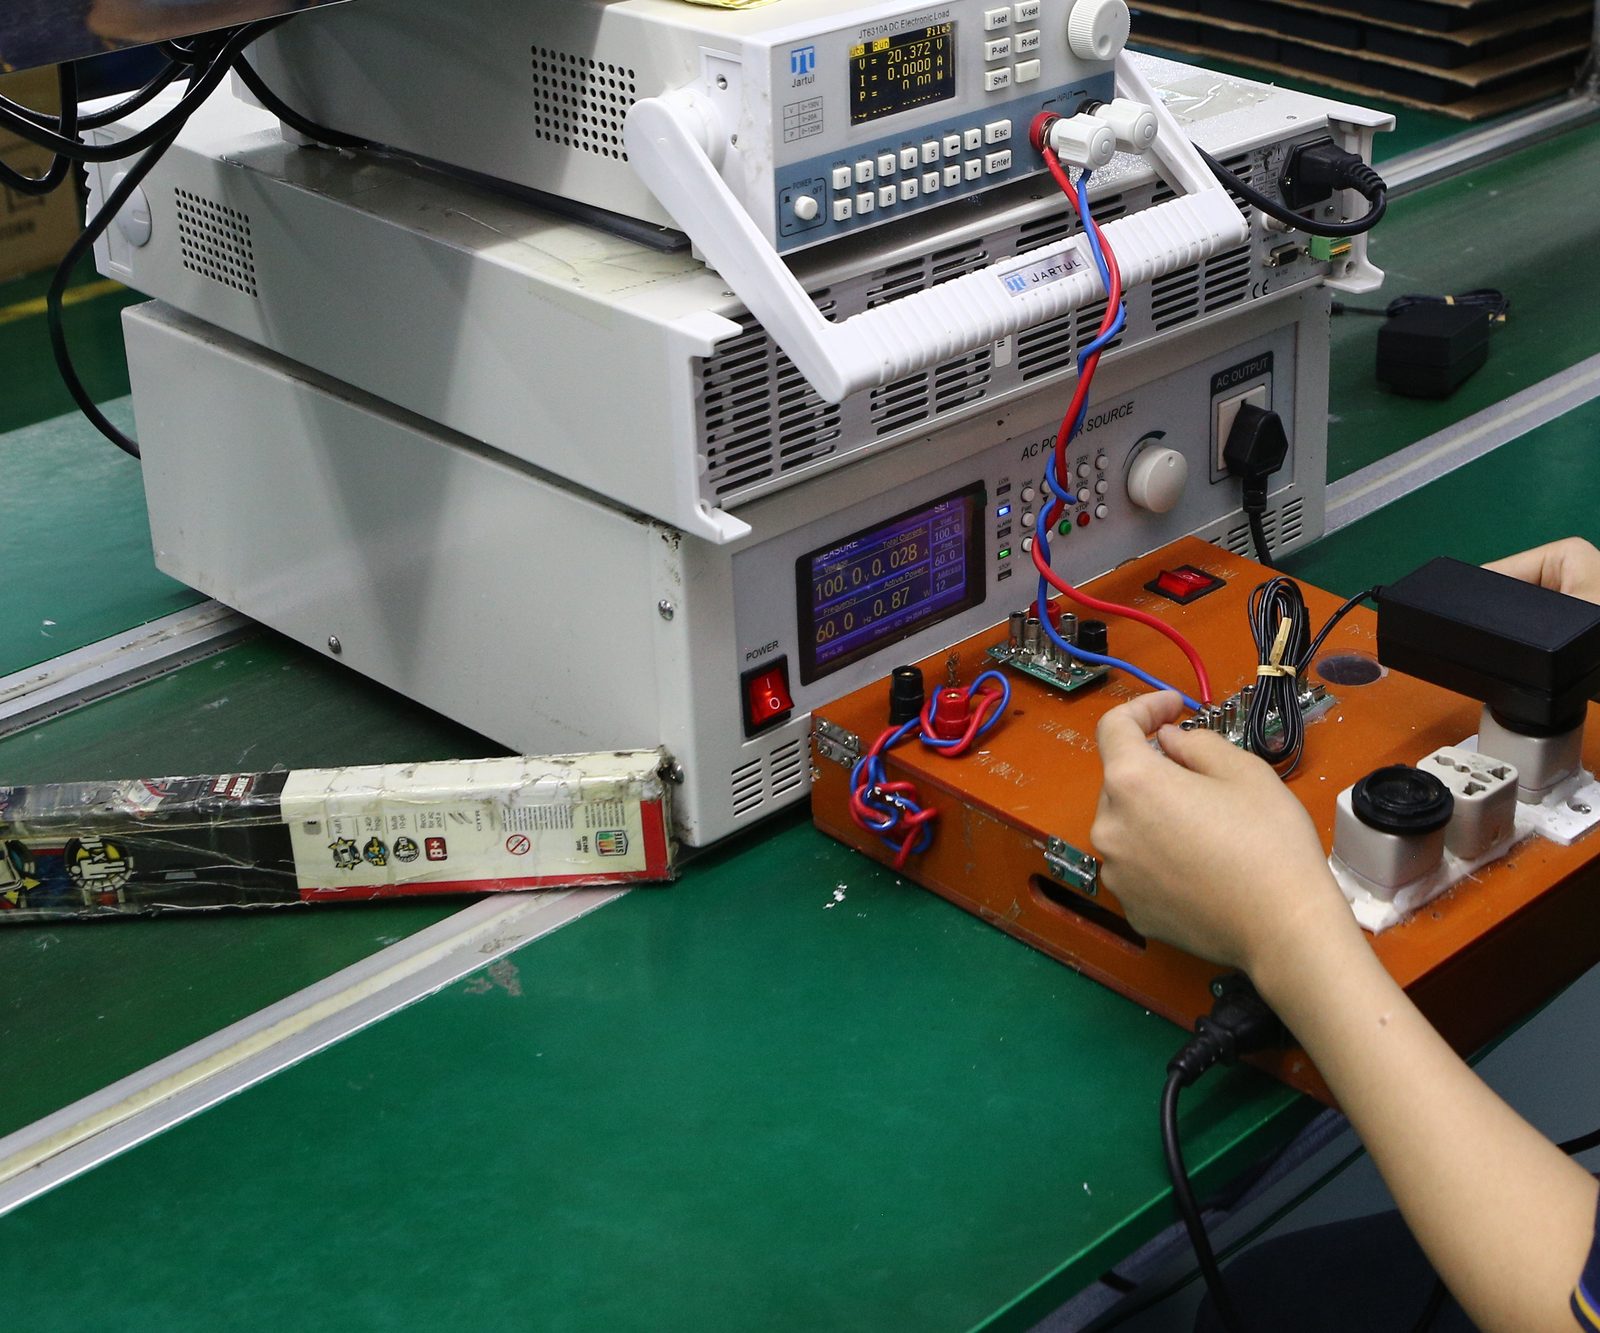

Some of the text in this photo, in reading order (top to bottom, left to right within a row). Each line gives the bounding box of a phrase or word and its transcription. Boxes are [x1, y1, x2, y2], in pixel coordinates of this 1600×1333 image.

[1022, 7, 1038, 17] V-set
[859, 9, 950, 39] JT6310A DC Electronic Load
[993, 15, 1007, 24] I-set
[850, 45, 864, 55] uto
[873, 40, 889, 50] Run
[1021, 37, 1038, 47] R-set
[859, 58, 866, 70] V
[887, 41, 931, 65] 20.372
[936, 38, 943, 50] V
[992, 45, 1009, 55] P-set
[887, 58, 931, 80] 0.0000
[936, 55, 943, 66] A
[791, 74, 815, 88] Jartul
[993, 75, 1008, 86] Shift
[859, 91, 866, 102] P
[994, 129, 1008, 138] Esc
[991, 157, 1010, 169] Enter
[1032, 259, 1081, 283] JARTUL
[1216, 357, 1268, 389] AC OUTPUT
[1021, 401, 1135, 461] AC POR SOURCE
[1075, 502, 1089, 512] STOP
[883, 528, 923, 548] Total Current
[884, 567, 925, 588] Active Power
[746, 640, 779, 661] POWER
